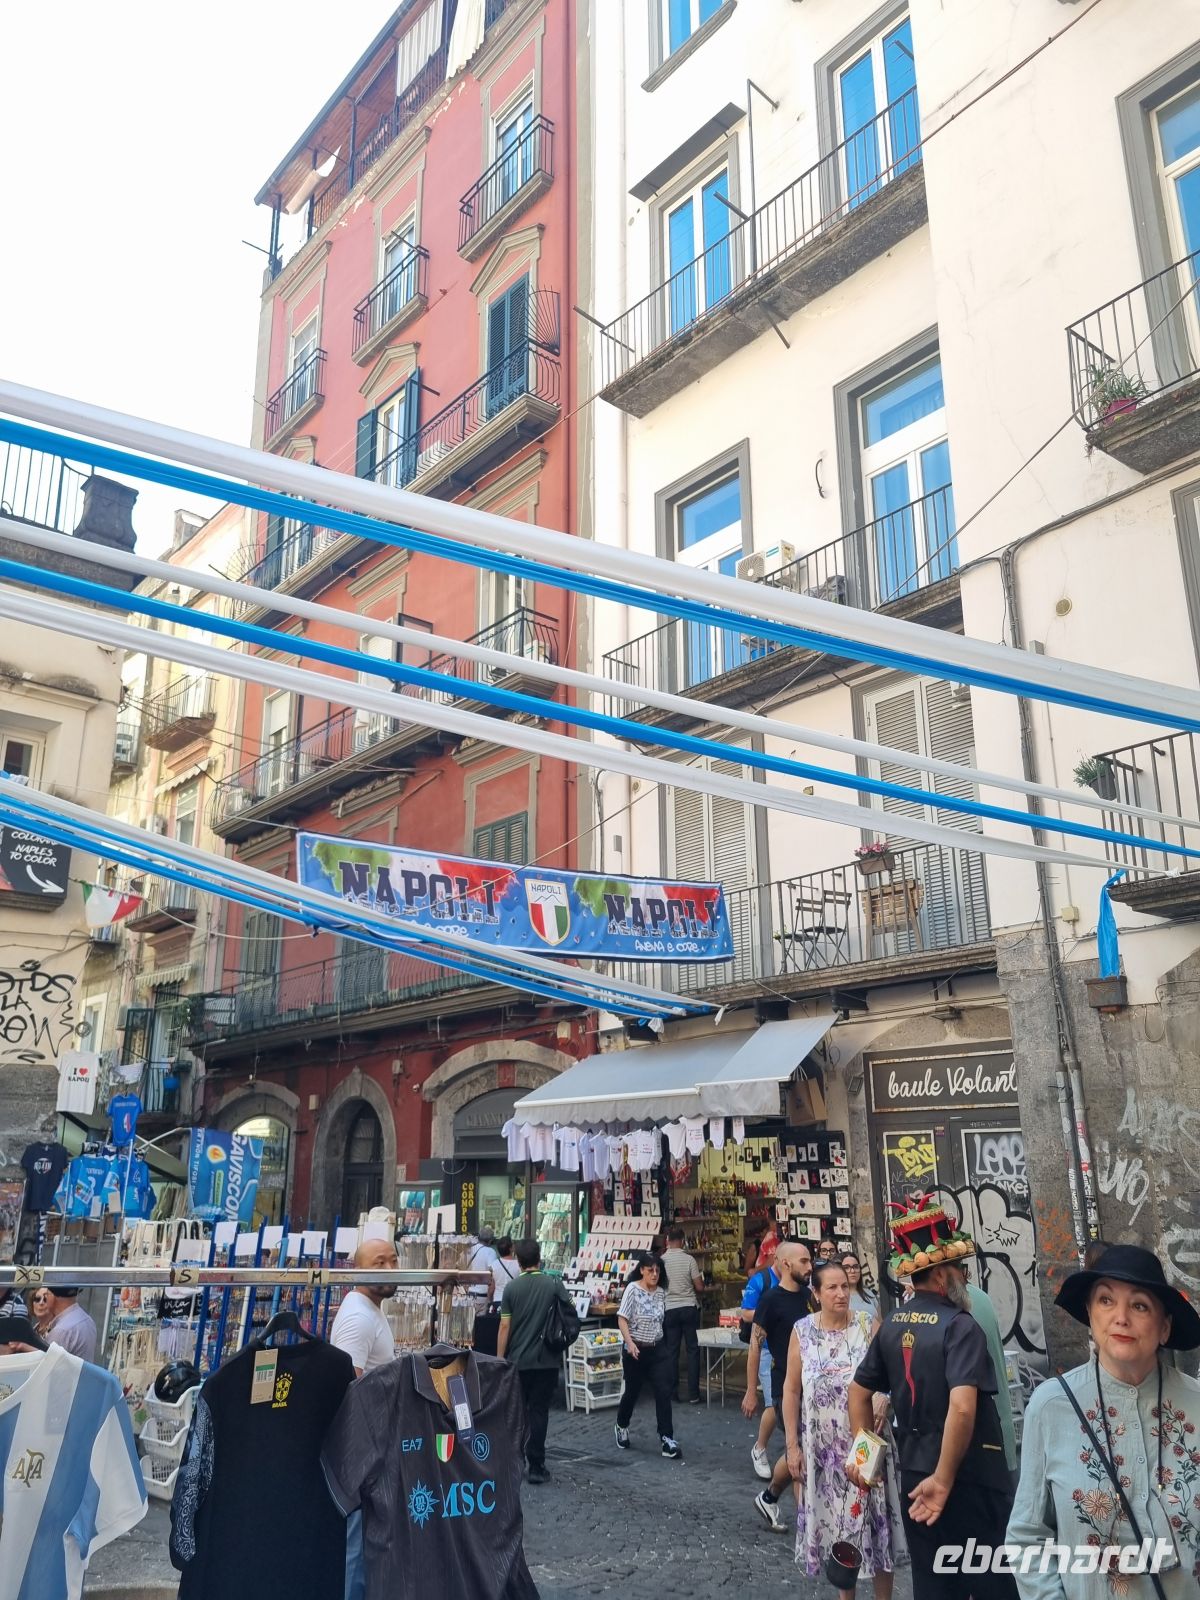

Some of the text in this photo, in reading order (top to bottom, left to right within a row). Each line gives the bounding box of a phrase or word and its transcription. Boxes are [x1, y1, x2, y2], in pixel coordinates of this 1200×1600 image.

[15, 844, 53, 857] NAPLES
[10, 851, 58, 867] TO COLOR
[338, 861, 500, 924] NAPOLI
[530, 884, 561, 895] NAPOLI
[603, 894, 719, 938] NAPOLI
[888, 1068, 944, 1099] baule
[17, 1267, 42, 1282] XS
[178, 1269, 192, 1283] S
[311, 1271, 322, 1284] M
[401, 1437, 423, 1451] EA7
[440, 1480, 496, 1518] MSC
